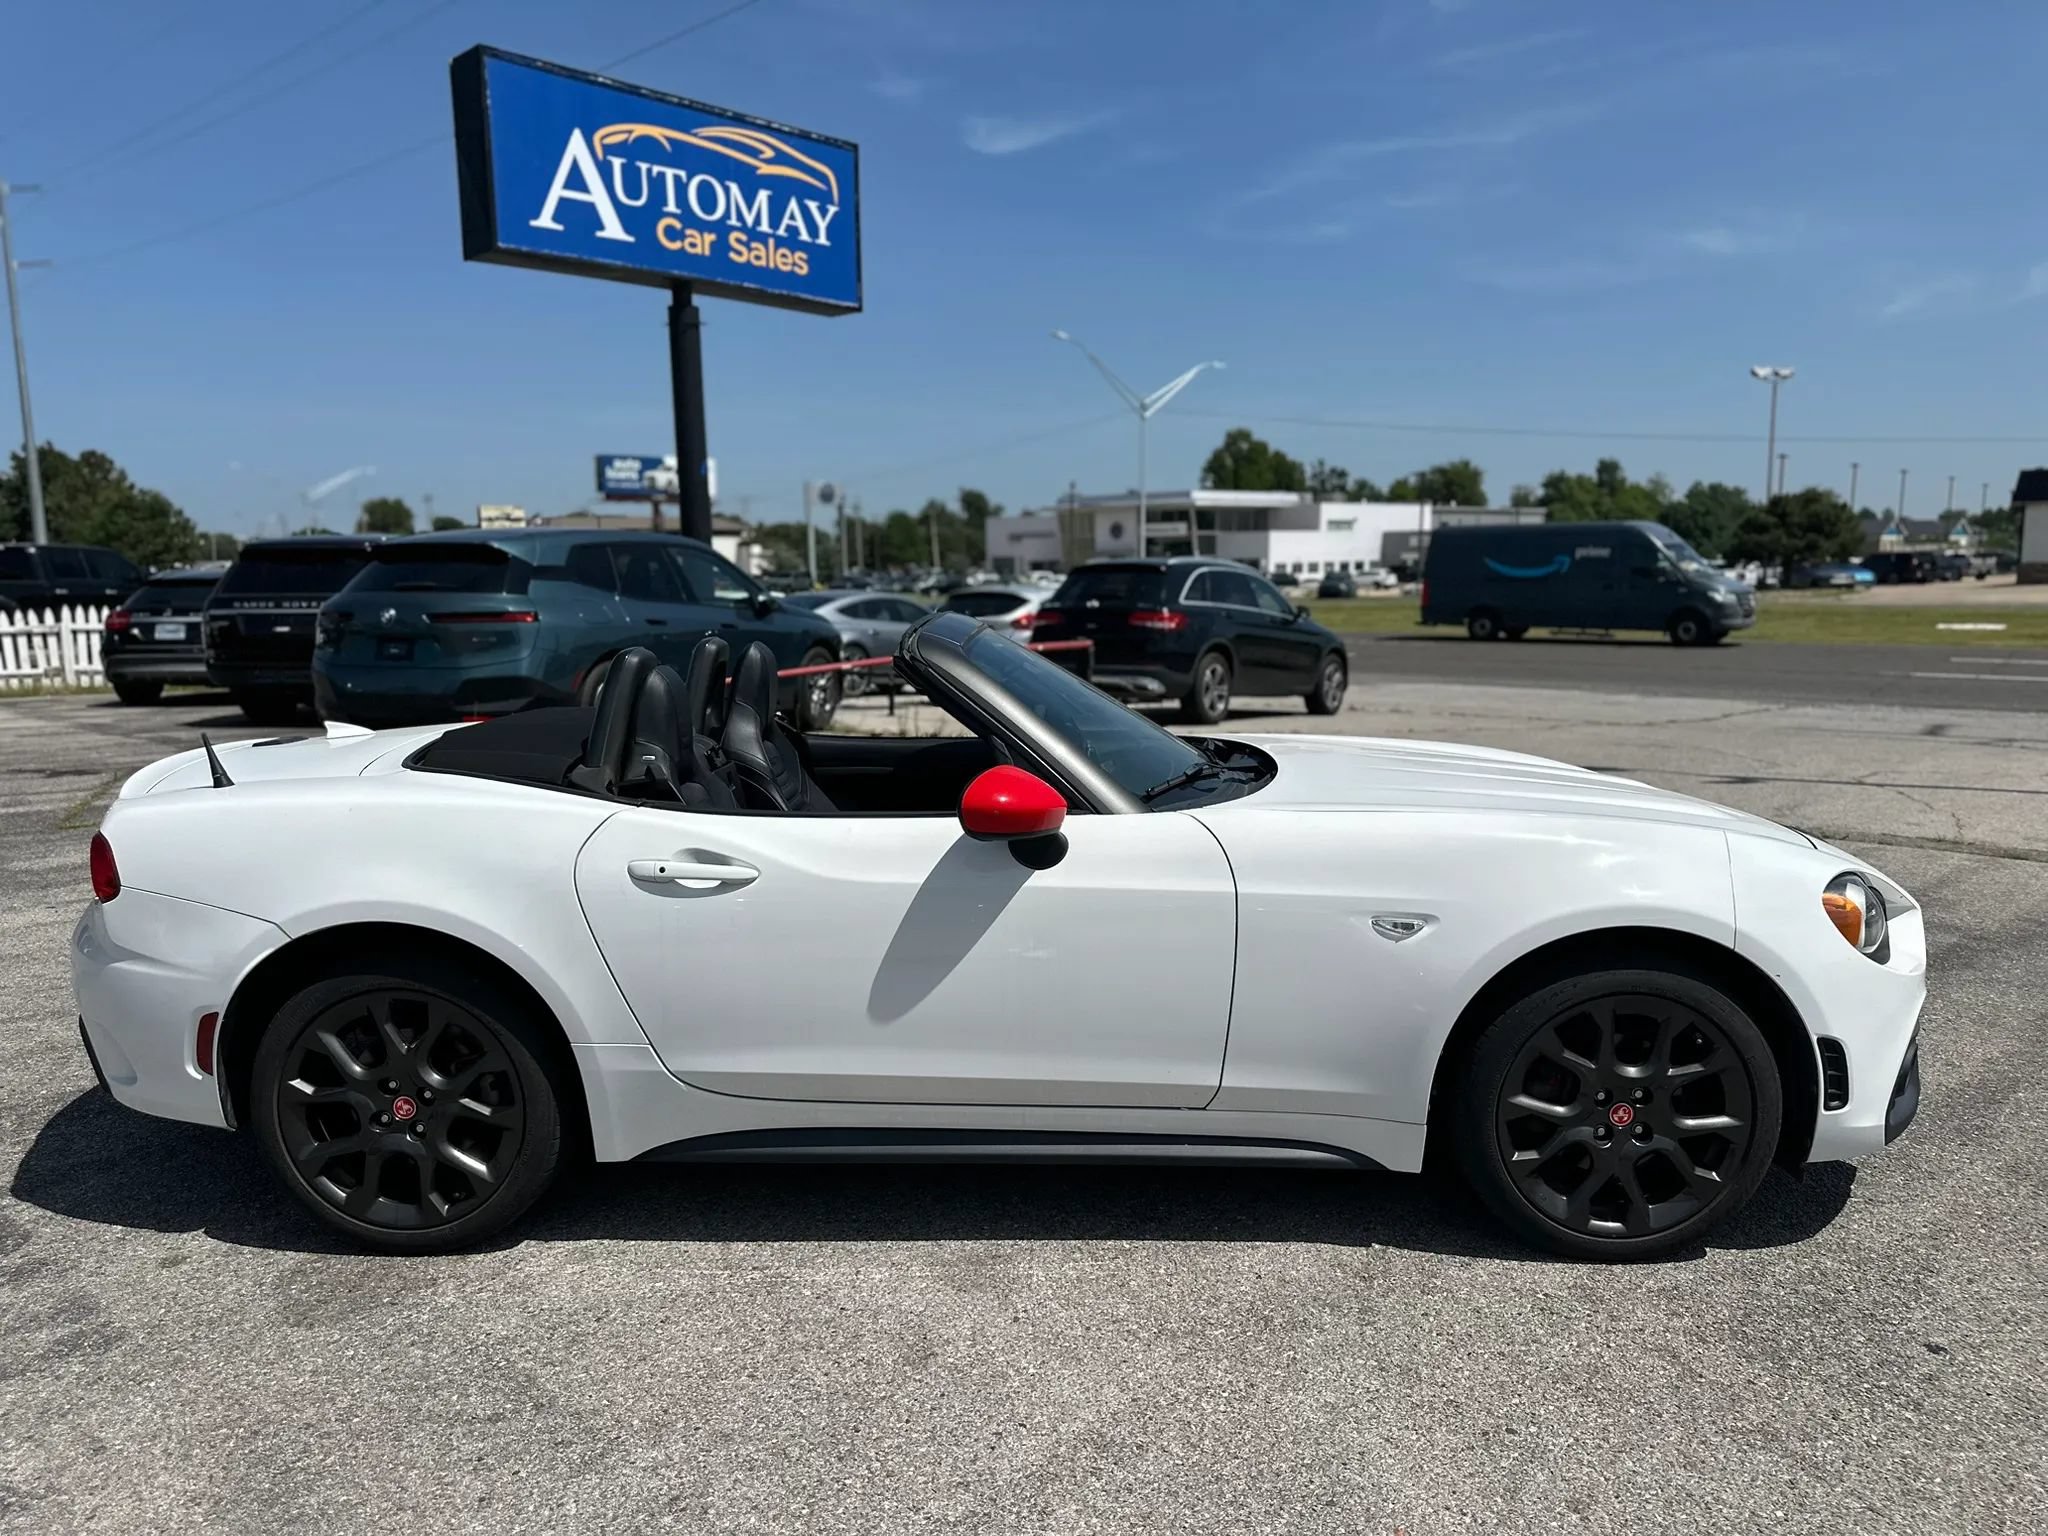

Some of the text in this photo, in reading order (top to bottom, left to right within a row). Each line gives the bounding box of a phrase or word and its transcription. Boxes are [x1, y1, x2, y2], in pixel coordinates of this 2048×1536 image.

[528, 126, 839, 246] AUTOMAY
[656, 217, 809, 275] Car Sales
